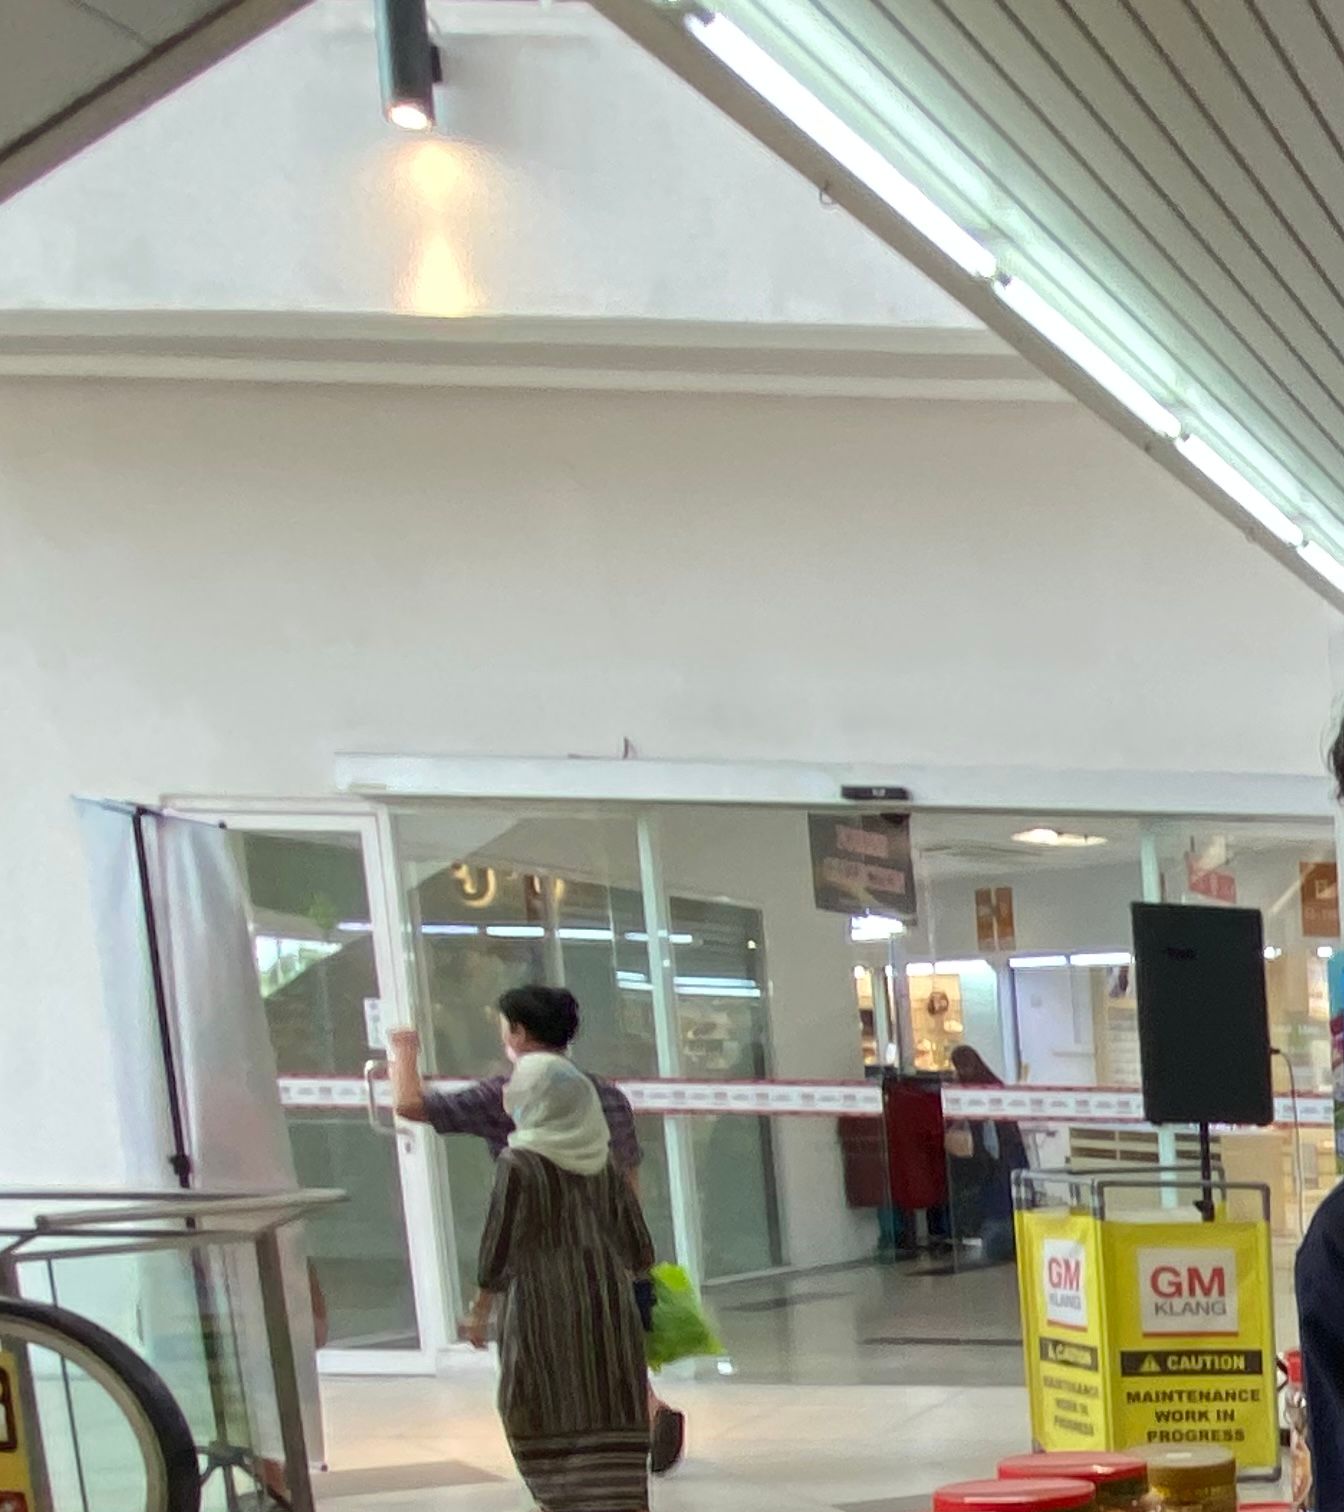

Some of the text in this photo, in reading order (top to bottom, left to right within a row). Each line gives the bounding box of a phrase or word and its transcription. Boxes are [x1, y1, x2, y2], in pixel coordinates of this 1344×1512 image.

[1048, 1257, 1081, 1292] GM
[1151, 1265, 1225, 1298] GM
[1154, 1301, 1226, 1316] KLANG
[1167, 1355, 1245, 1371] CAUTION
[1126, 1388, 1261, 1404] MAINTENANCE
[1155, 1409, 1235, 1423] WORK IN
[1147, 1429, 1245, 1443] PROGRESS
